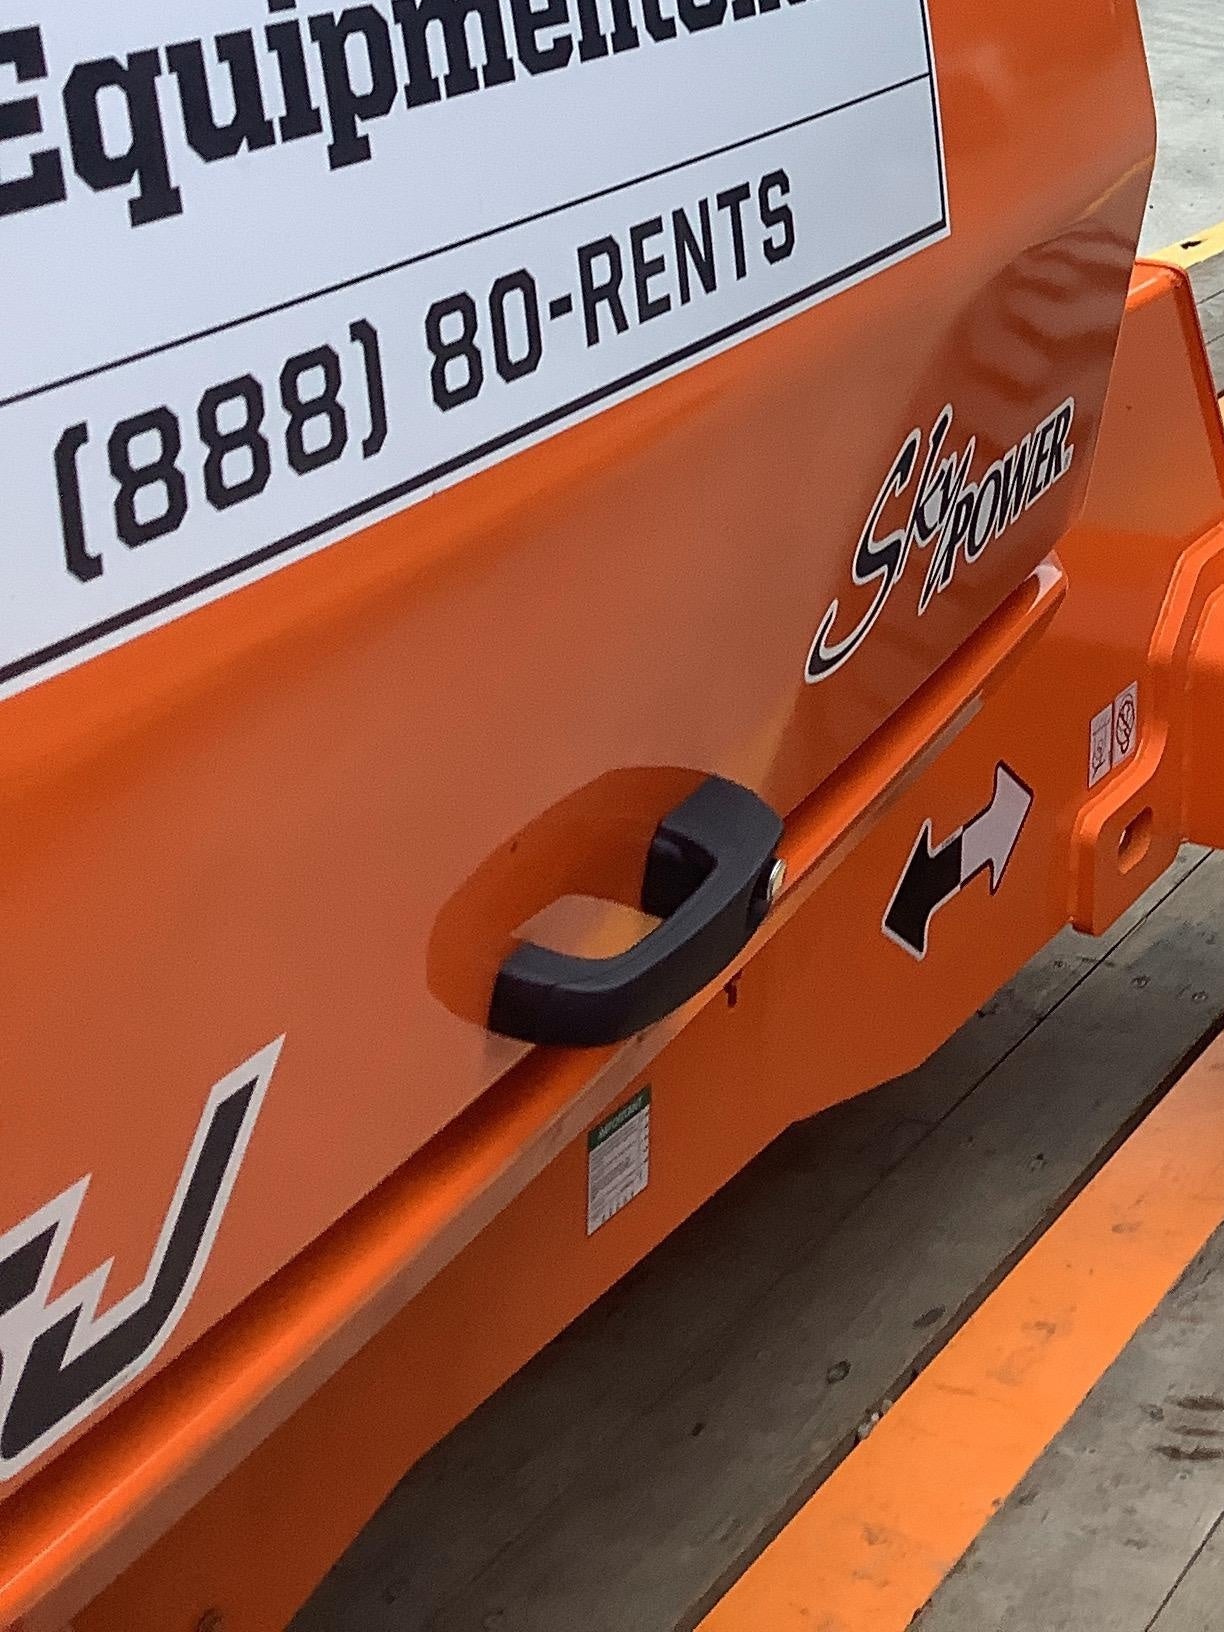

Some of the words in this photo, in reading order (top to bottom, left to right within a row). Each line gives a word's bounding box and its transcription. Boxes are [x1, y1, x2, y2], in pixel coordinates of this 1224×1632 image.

[53, 320, 389, 582] (888)
[424, 169, 797, 413] 80-RENTS
[937, 400, 1074, 590] POWER
